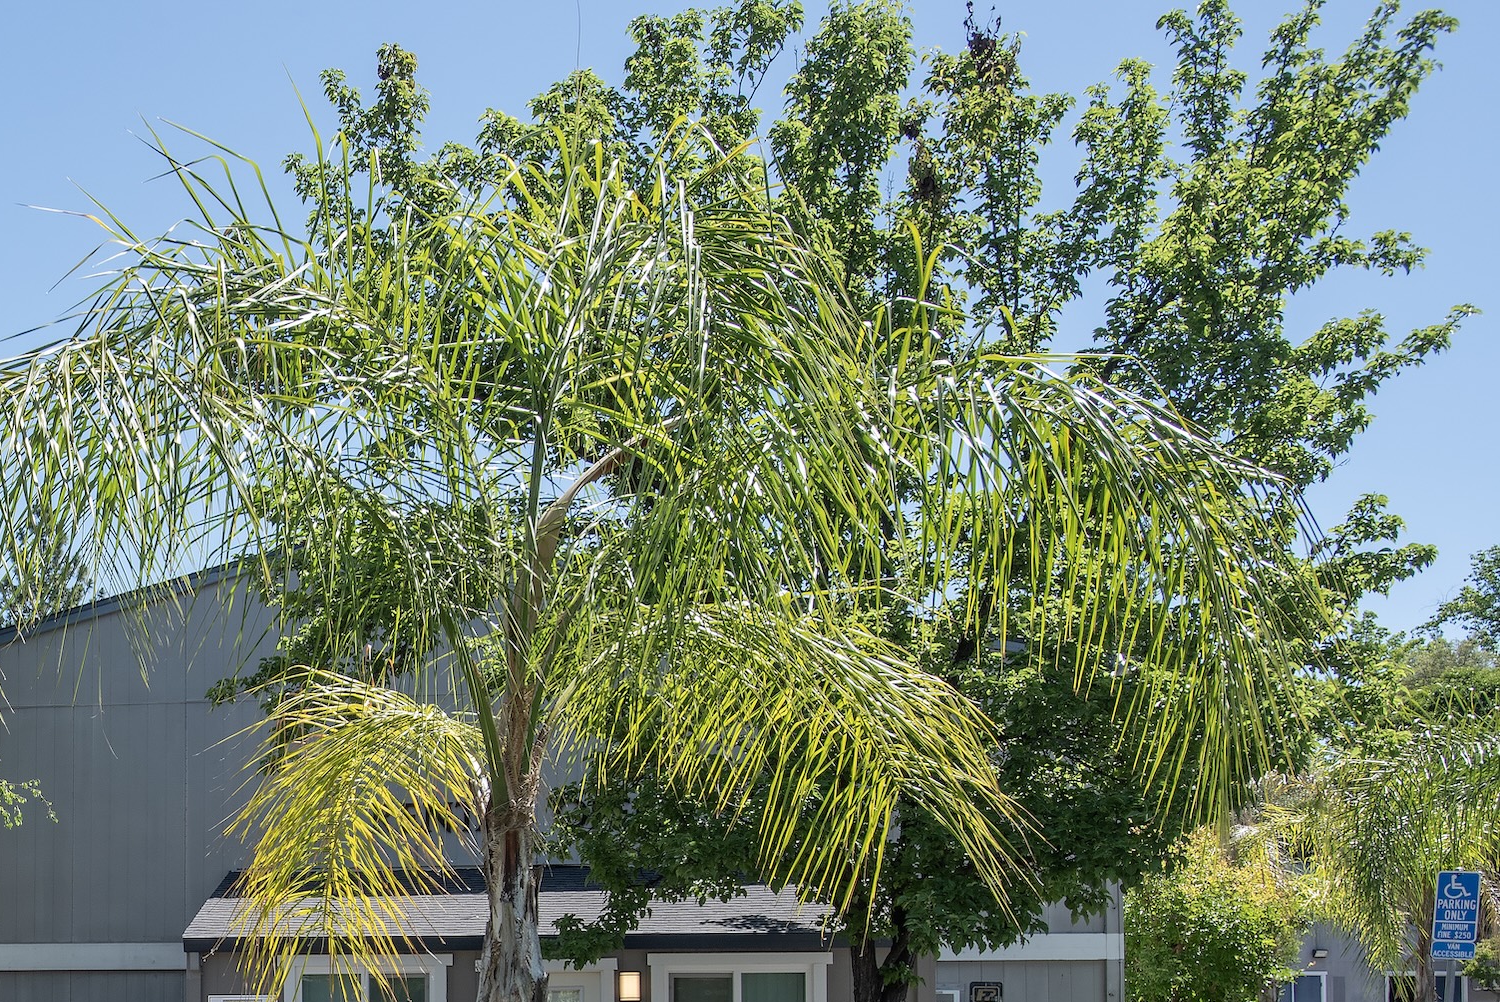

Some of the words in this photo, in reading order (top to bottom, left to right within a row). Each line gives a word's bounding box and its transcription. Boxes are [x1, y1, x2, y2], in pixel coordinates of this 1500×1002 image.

[1437, 898, 1476, 910] PARKING
[1444, 909, 1468, 920] ONLY
[1441, 923, 1468, 931] MINIMUM
[1437, 931, 1451, 939] FINE
[1454, 931, 1471, 939] $250
[1433, 949, 1473, 958] ACCESSIBLE
